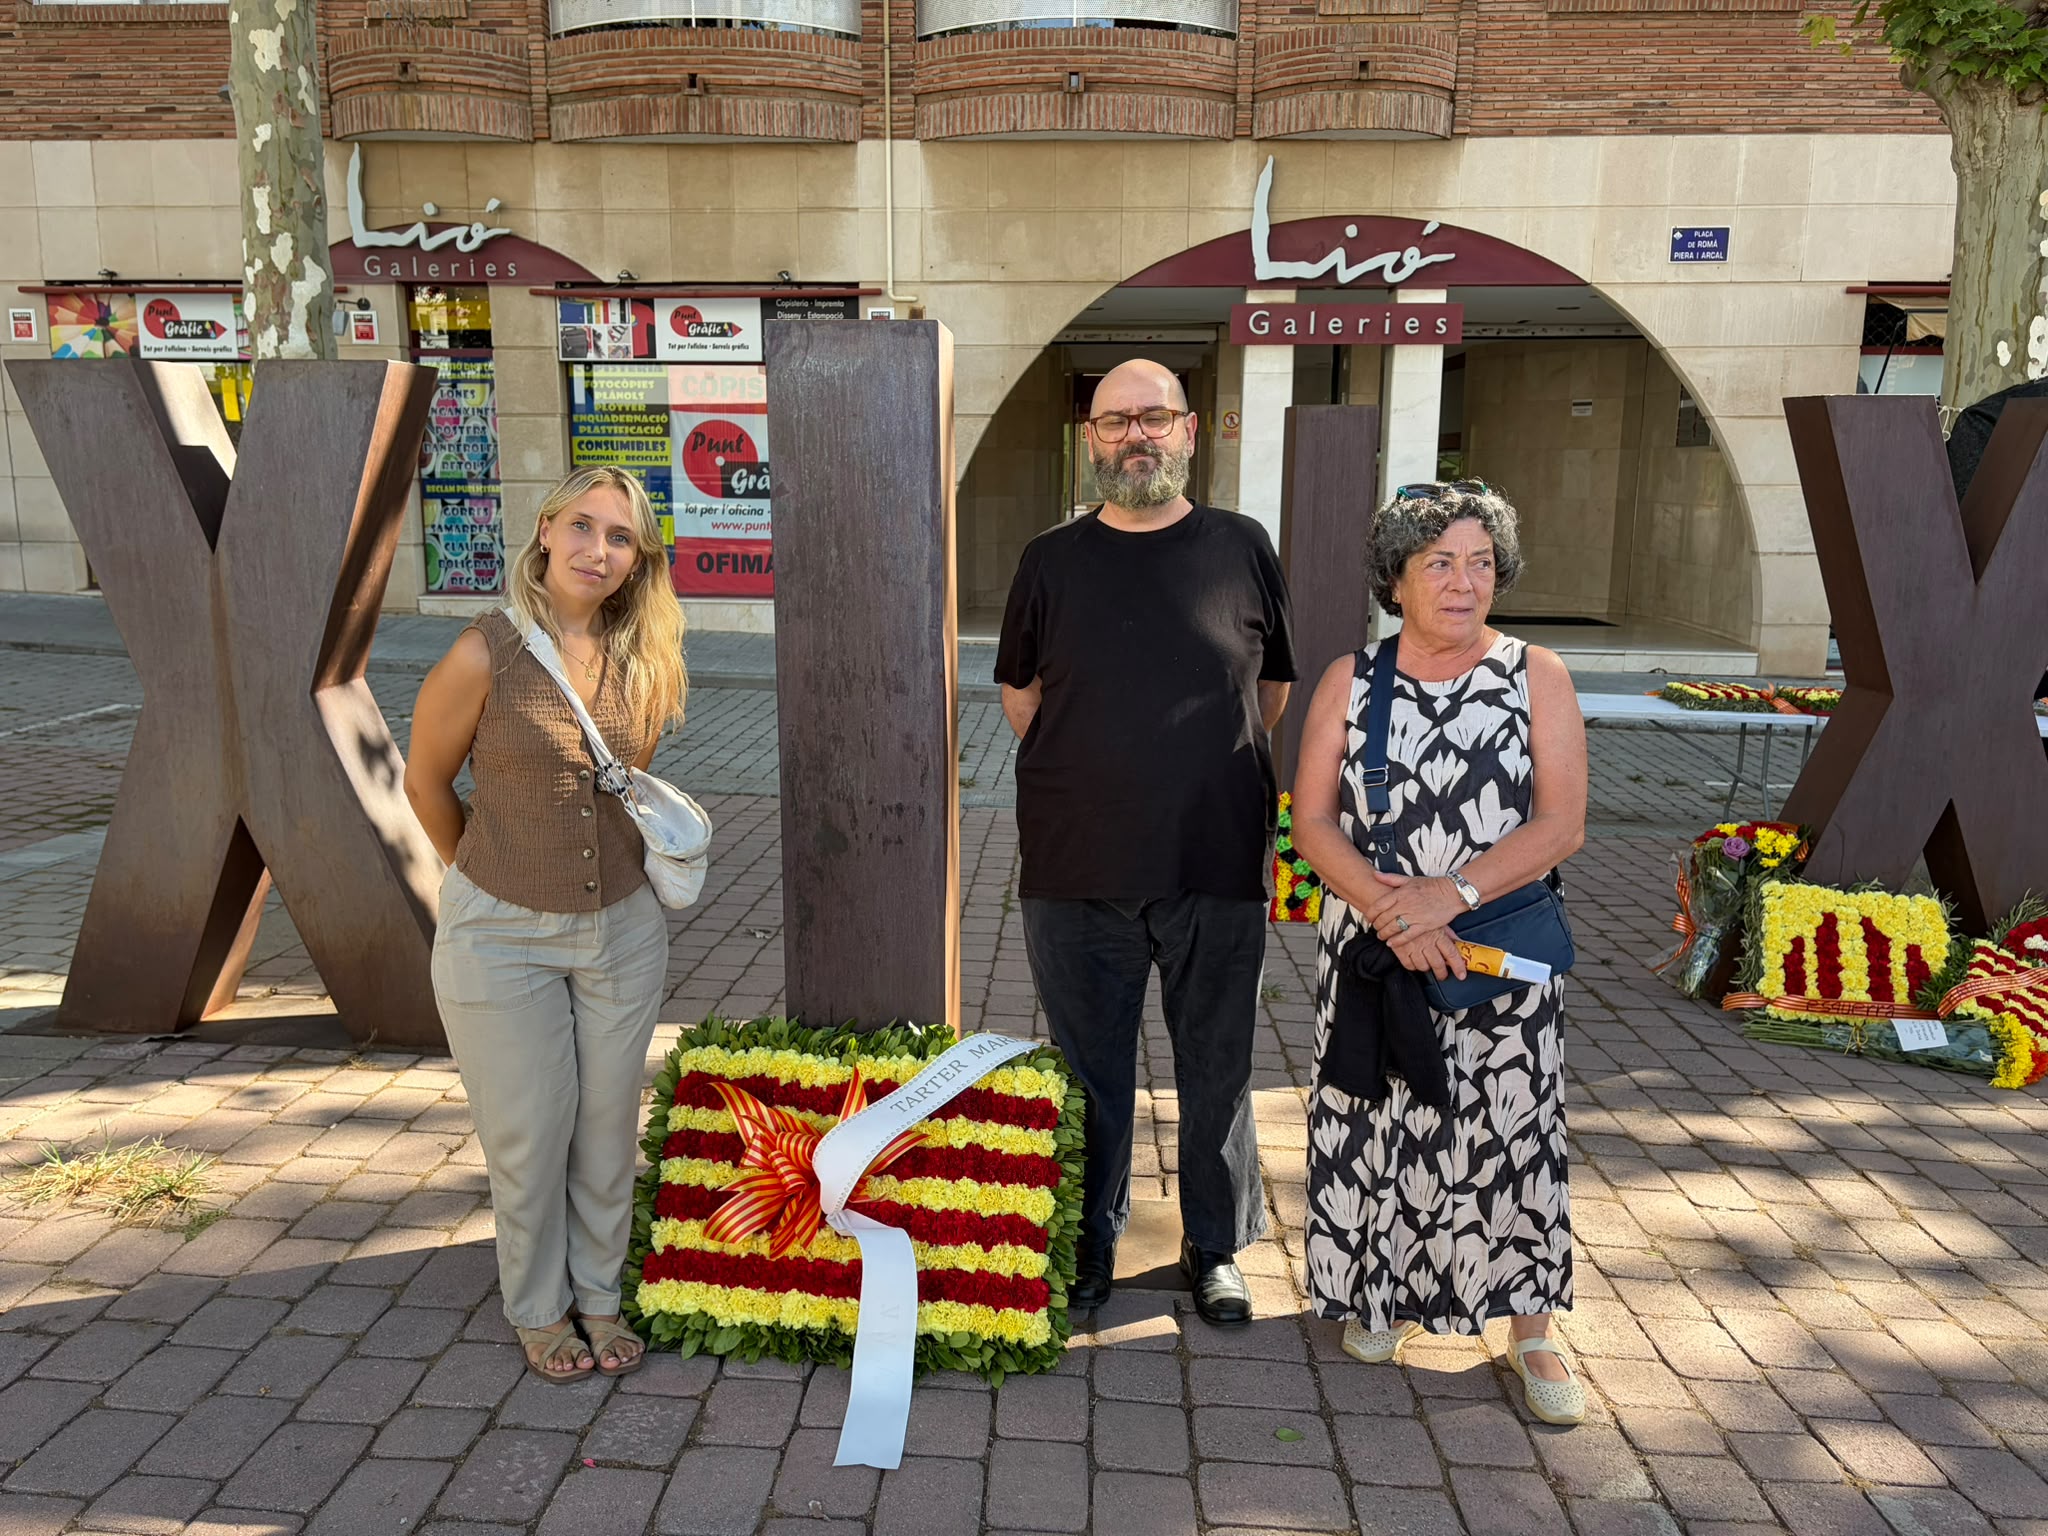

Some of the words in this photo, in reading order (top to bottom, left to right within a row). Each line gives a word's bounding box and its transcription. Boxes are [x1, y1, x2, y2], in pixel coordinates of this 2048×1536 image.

[1674, 252, 1694, 260] PIERA
[363, 255, 517, 277] Galeries
[776, 299, 809, 309] Copisteria
[814, 299, 845, 309] Impremta
[148, 304, 173, 318] Punt
[674, 310, 697, 321] Punt
[777, 311, 802, 320] Disseny
[807, 311, 844, 320] Estampació
[1248, 309, 1448, 335] Galeries
[165, 321, 203, 337] Gràfic
[688, 322, 722, 337] Gràfic
[143, 345, 154, 353] Tot
[155, 346, 163, 354] per
[191, 345, 212, 353] Serveis
[677, 343, 686, 351] per
[572, 412, 669, 423] ENQUADERNACIÓ
[579, 424, 663, 434] PLASTIFICACIÓ
[577, 440, 666, 452] CONSUMIBLES
[692, 431, 744, 454] Punt
[576, 454, 620, 462] ORIGINALS
[685, 503, 697, 514] Tot
[700, 505, 719, 517] per
[721, 503, 764, 516] l'oficina
[711, 521, 773, 534] www.punt
[890, 1058, 969, 1113] TARTER
